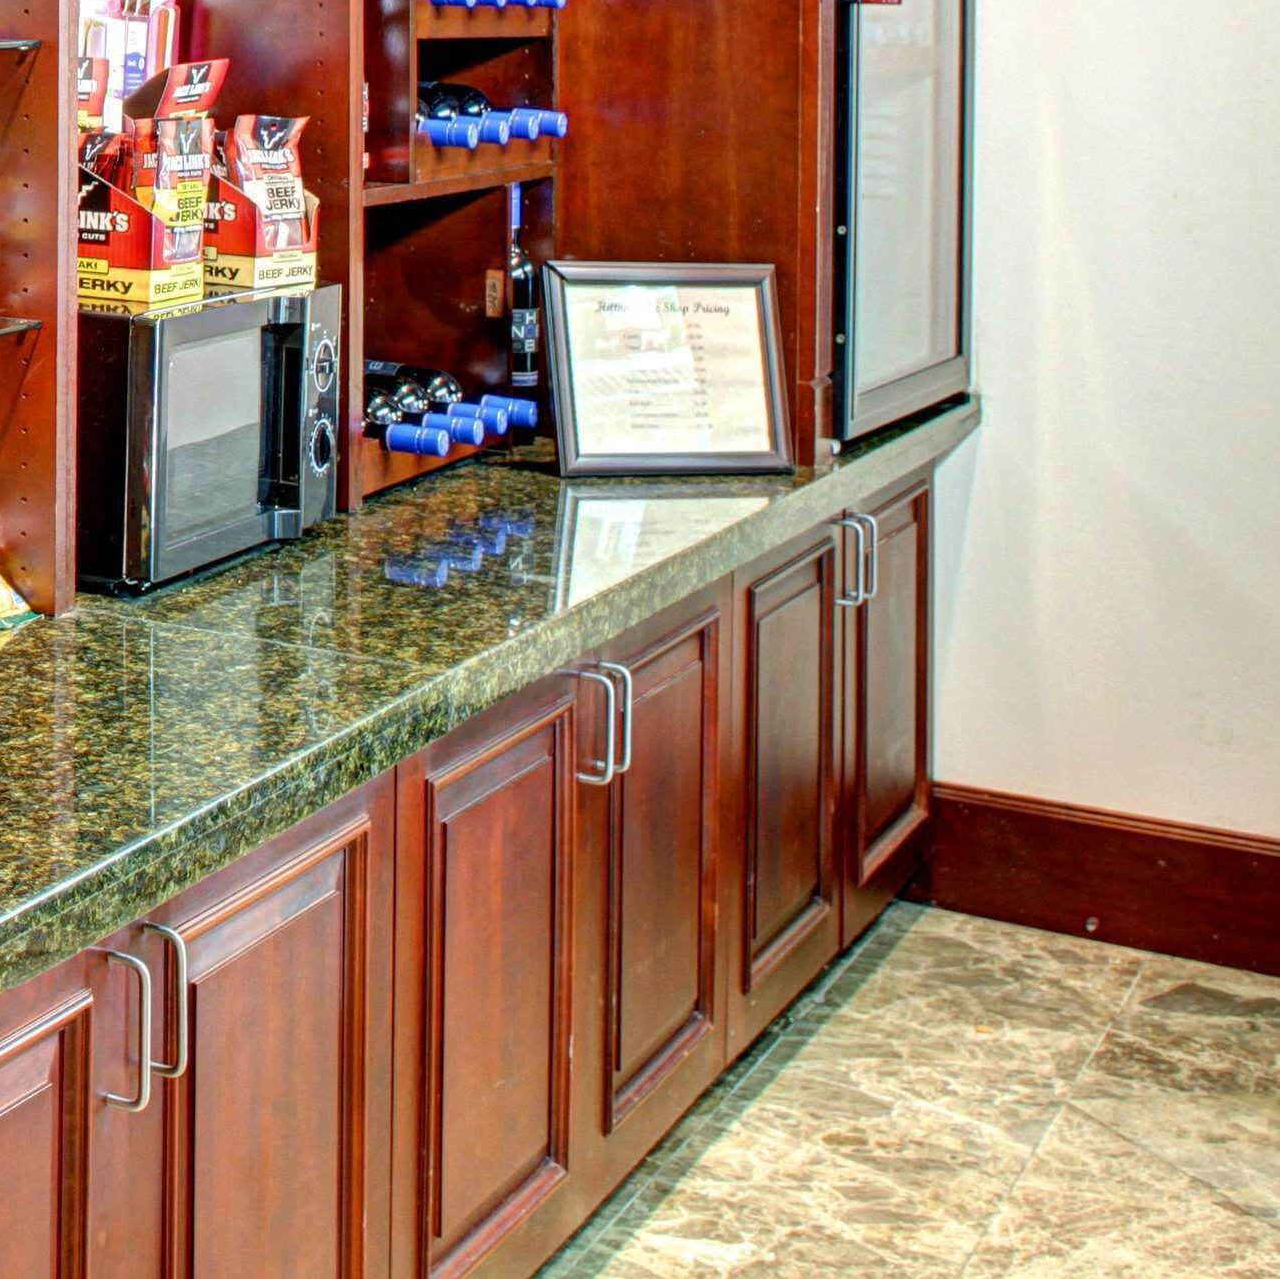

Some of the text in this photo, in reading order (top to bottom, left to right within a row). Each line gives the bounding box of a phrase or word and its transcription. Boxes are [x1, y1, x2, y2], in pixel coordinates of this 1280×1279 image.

[266, 185, 297, 199] BEEF
[177, 196, 203, 211] BEEF
[265, 198, 302, 212] JERKY
[78, 210, 131, 233] INK'S
[169, 207, 204, 224] JERKY
[81, 232, 107, 242] CUTS
[258, 264, 314, 280] BEEF JERKY
[78, 277, 135, 295] ERKY
[154, 281, 179, 295] BEEF
[692, 302, 731, 316] Pricing
